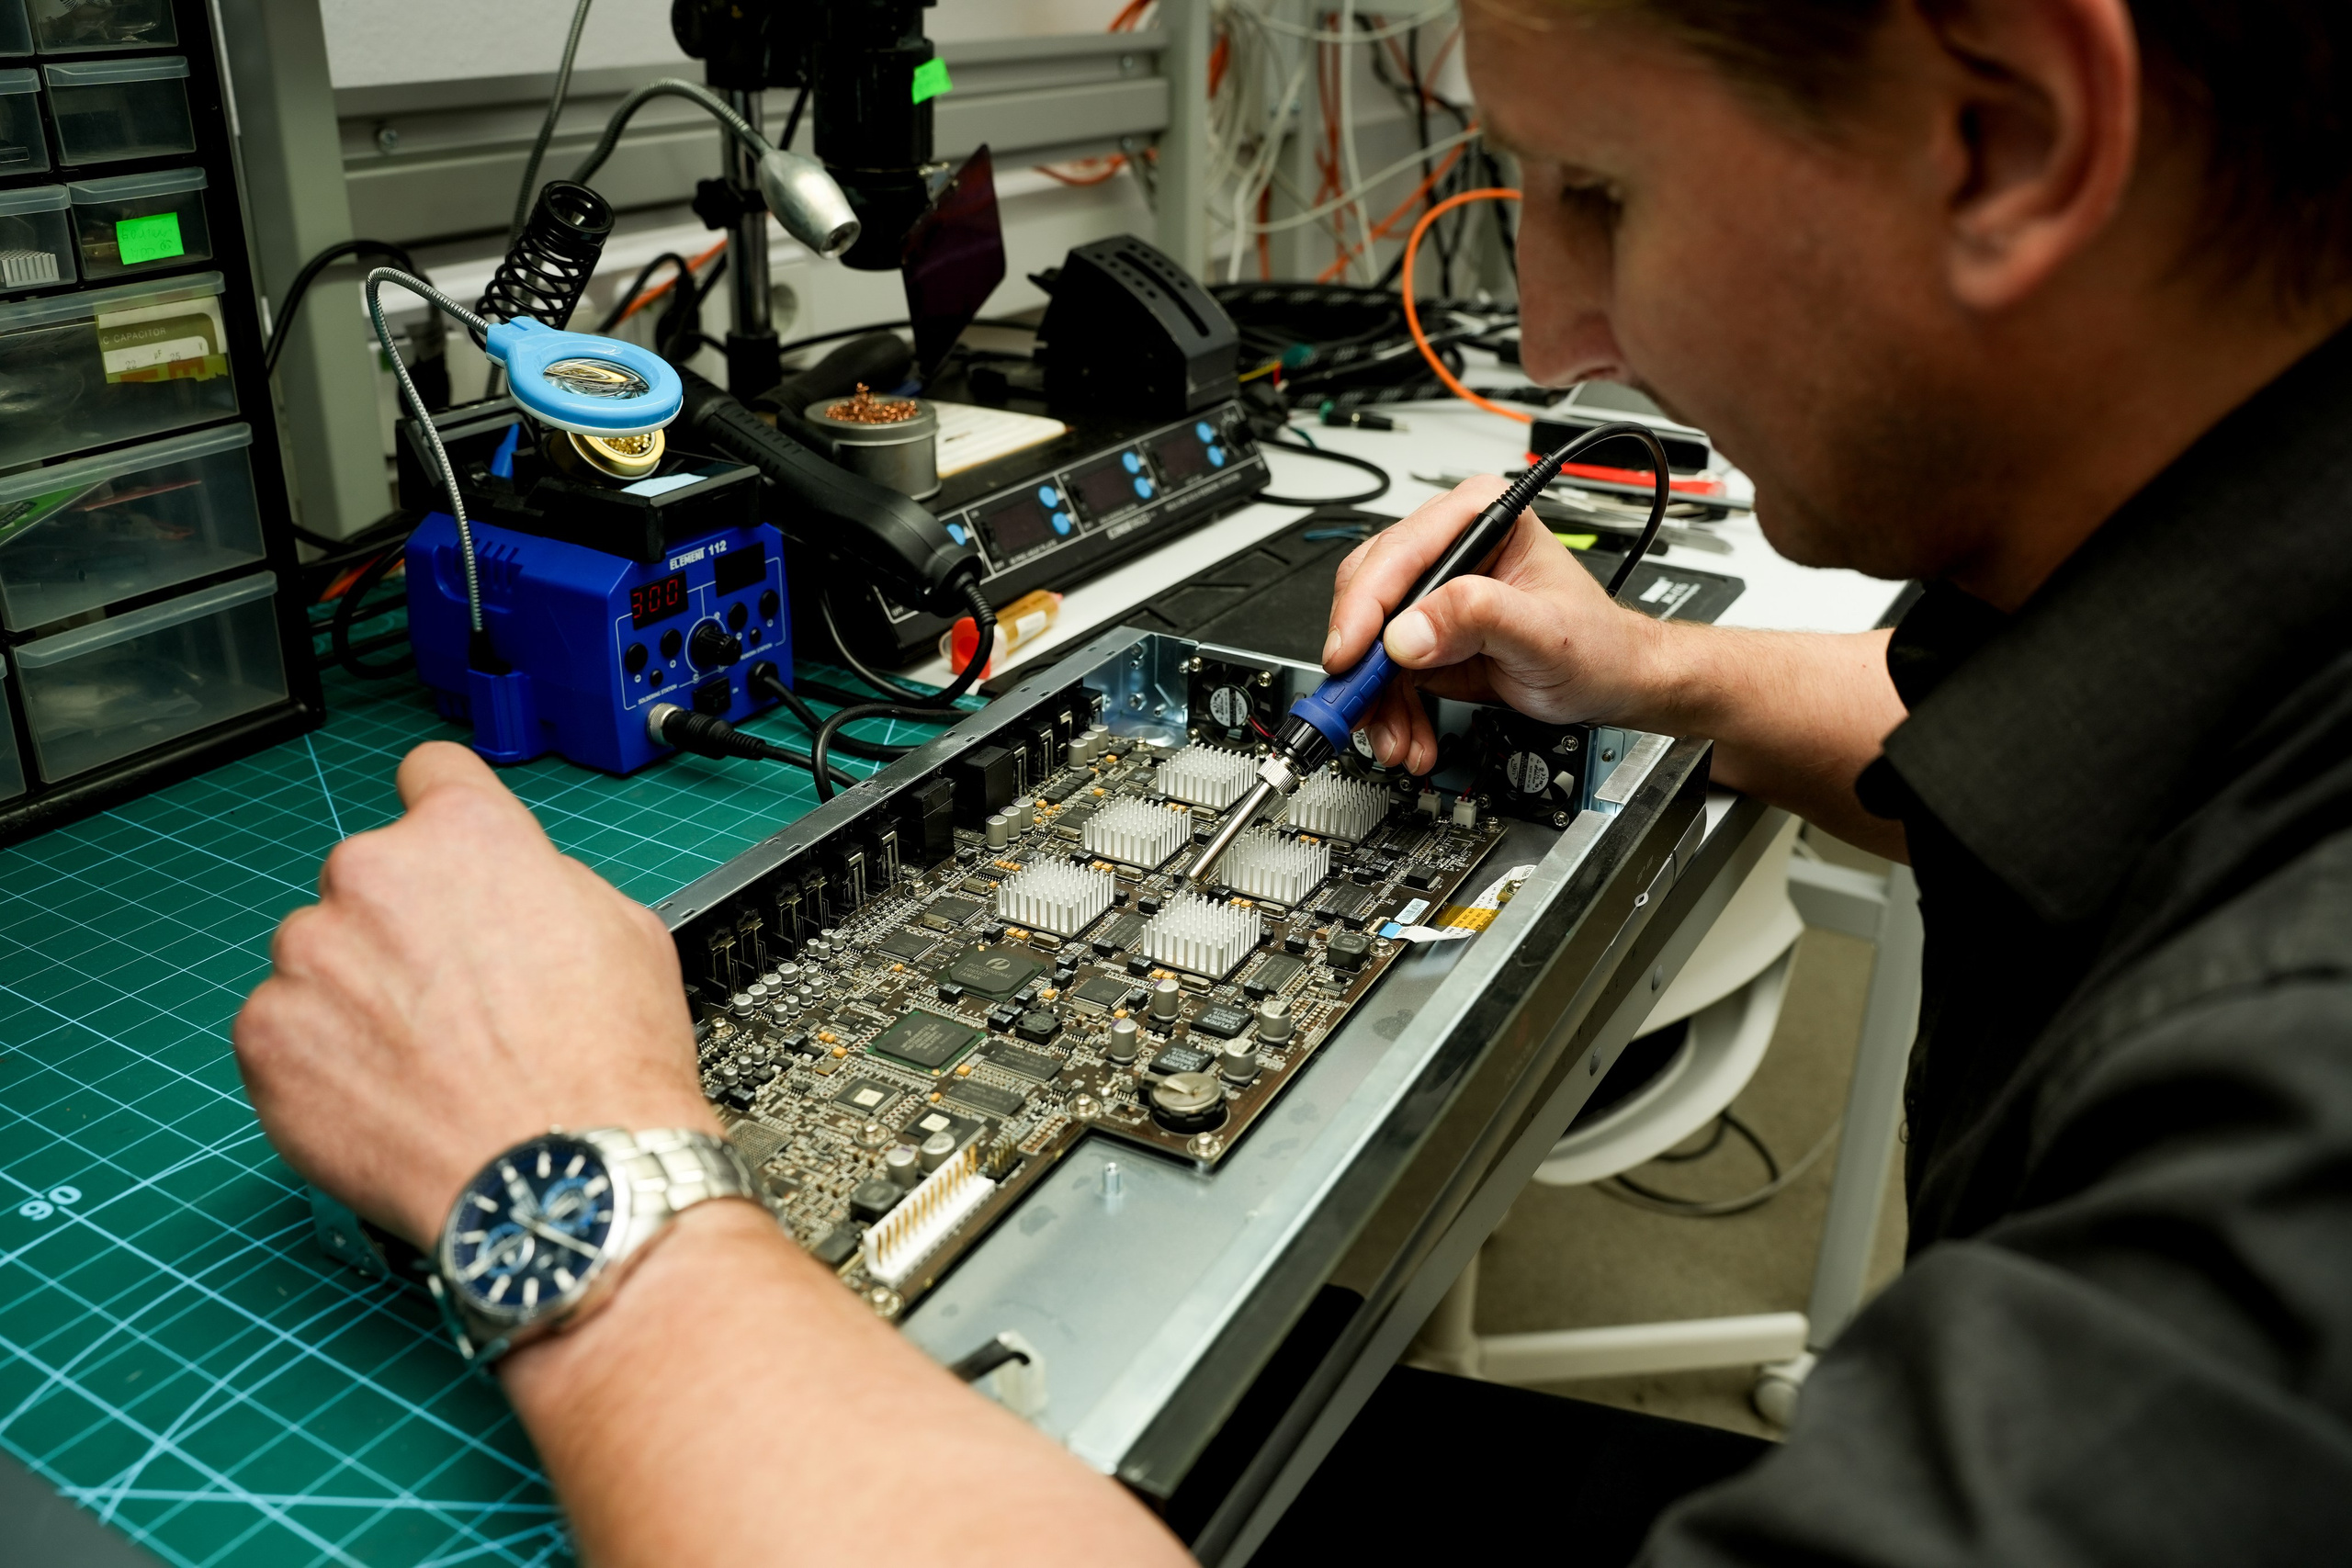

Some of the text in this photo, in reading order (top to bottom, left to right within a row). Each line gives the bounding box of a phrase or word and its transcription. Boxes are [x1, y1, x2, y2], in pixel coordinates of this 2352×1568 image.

[113, 327, 166, 343] CAPACITOR
[169, 352, 181, 362] 25
[669, 540, 727, 570] ELEMENT 112
[632, 579, 678, 619] 300
[958, 971, 981, 981] TAIWAN
[18, 1185, 82, 1221] 90
